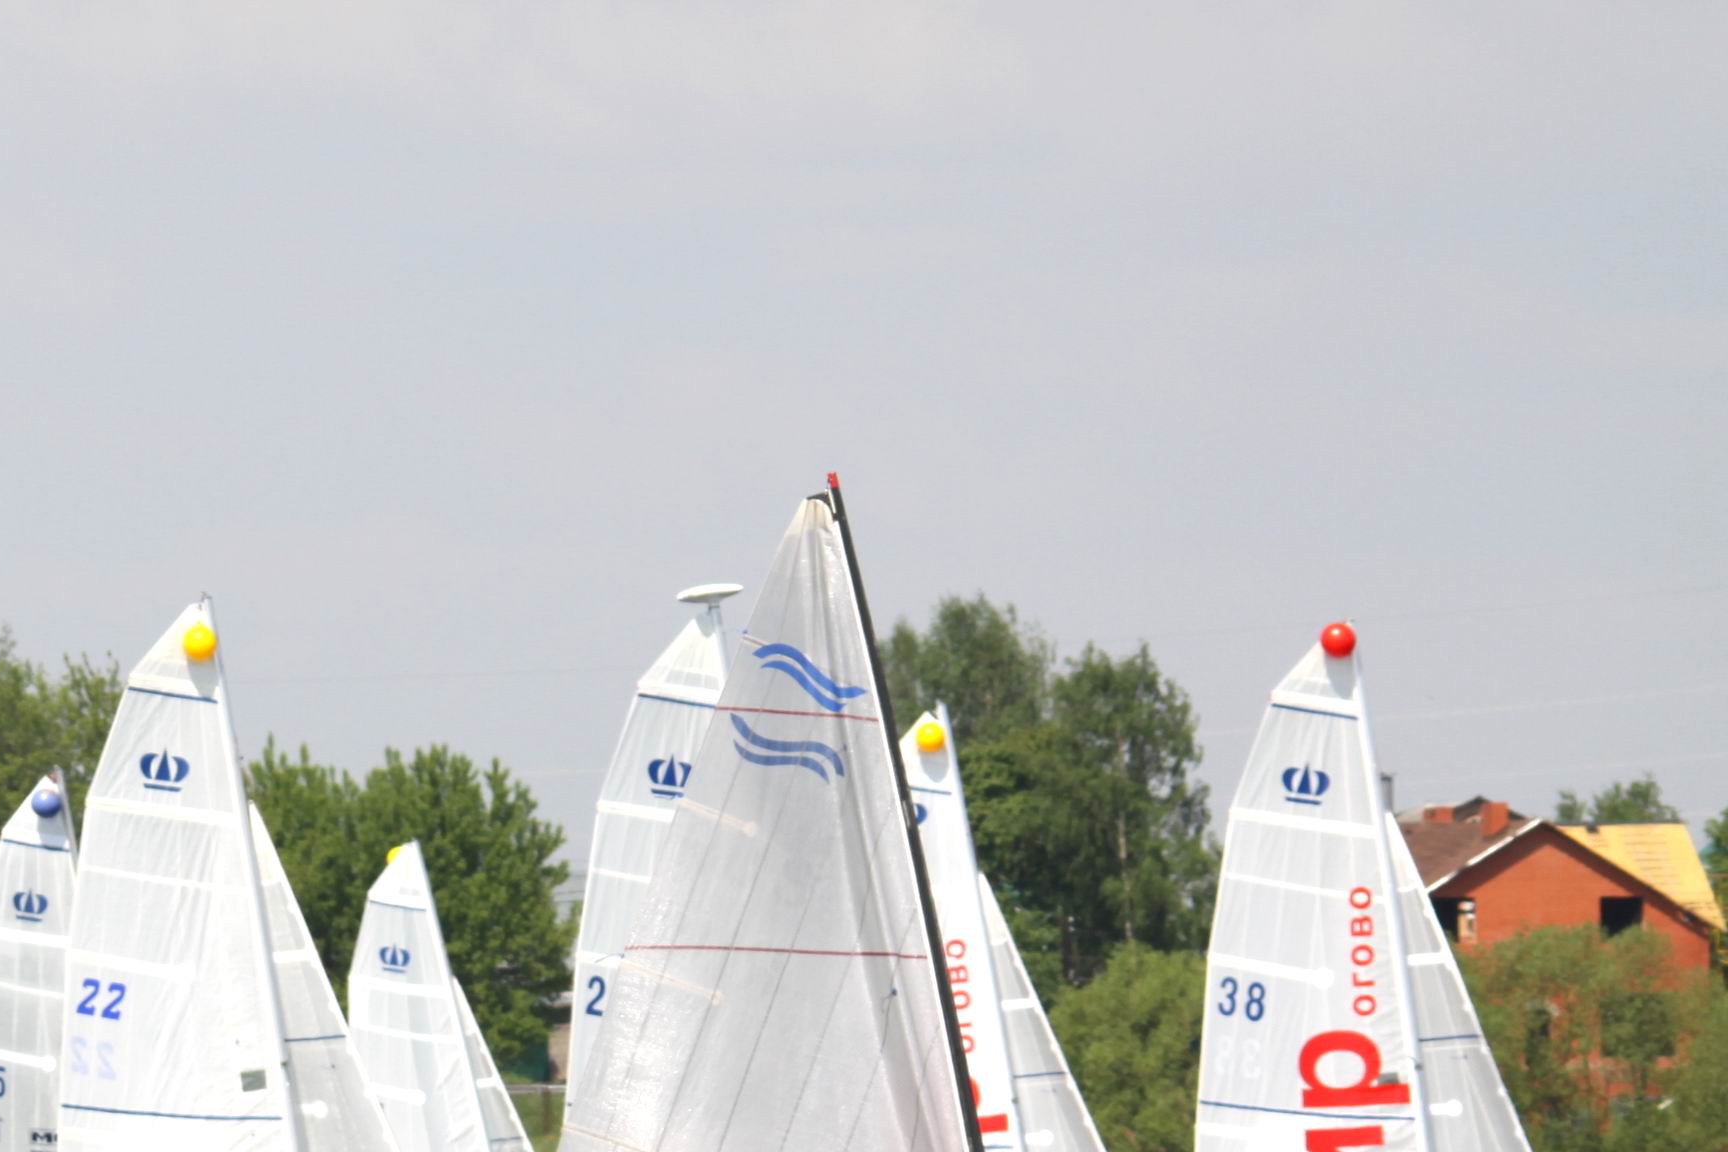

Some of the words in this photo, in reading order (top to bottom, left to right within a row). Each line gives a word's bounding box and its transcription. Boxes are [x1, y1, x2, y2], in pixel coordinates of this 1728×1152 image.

[76, 978, 126, 1020] 22
[586, 976, 605, 1016] 2
[1218, 977, 1264, 1021] 38
